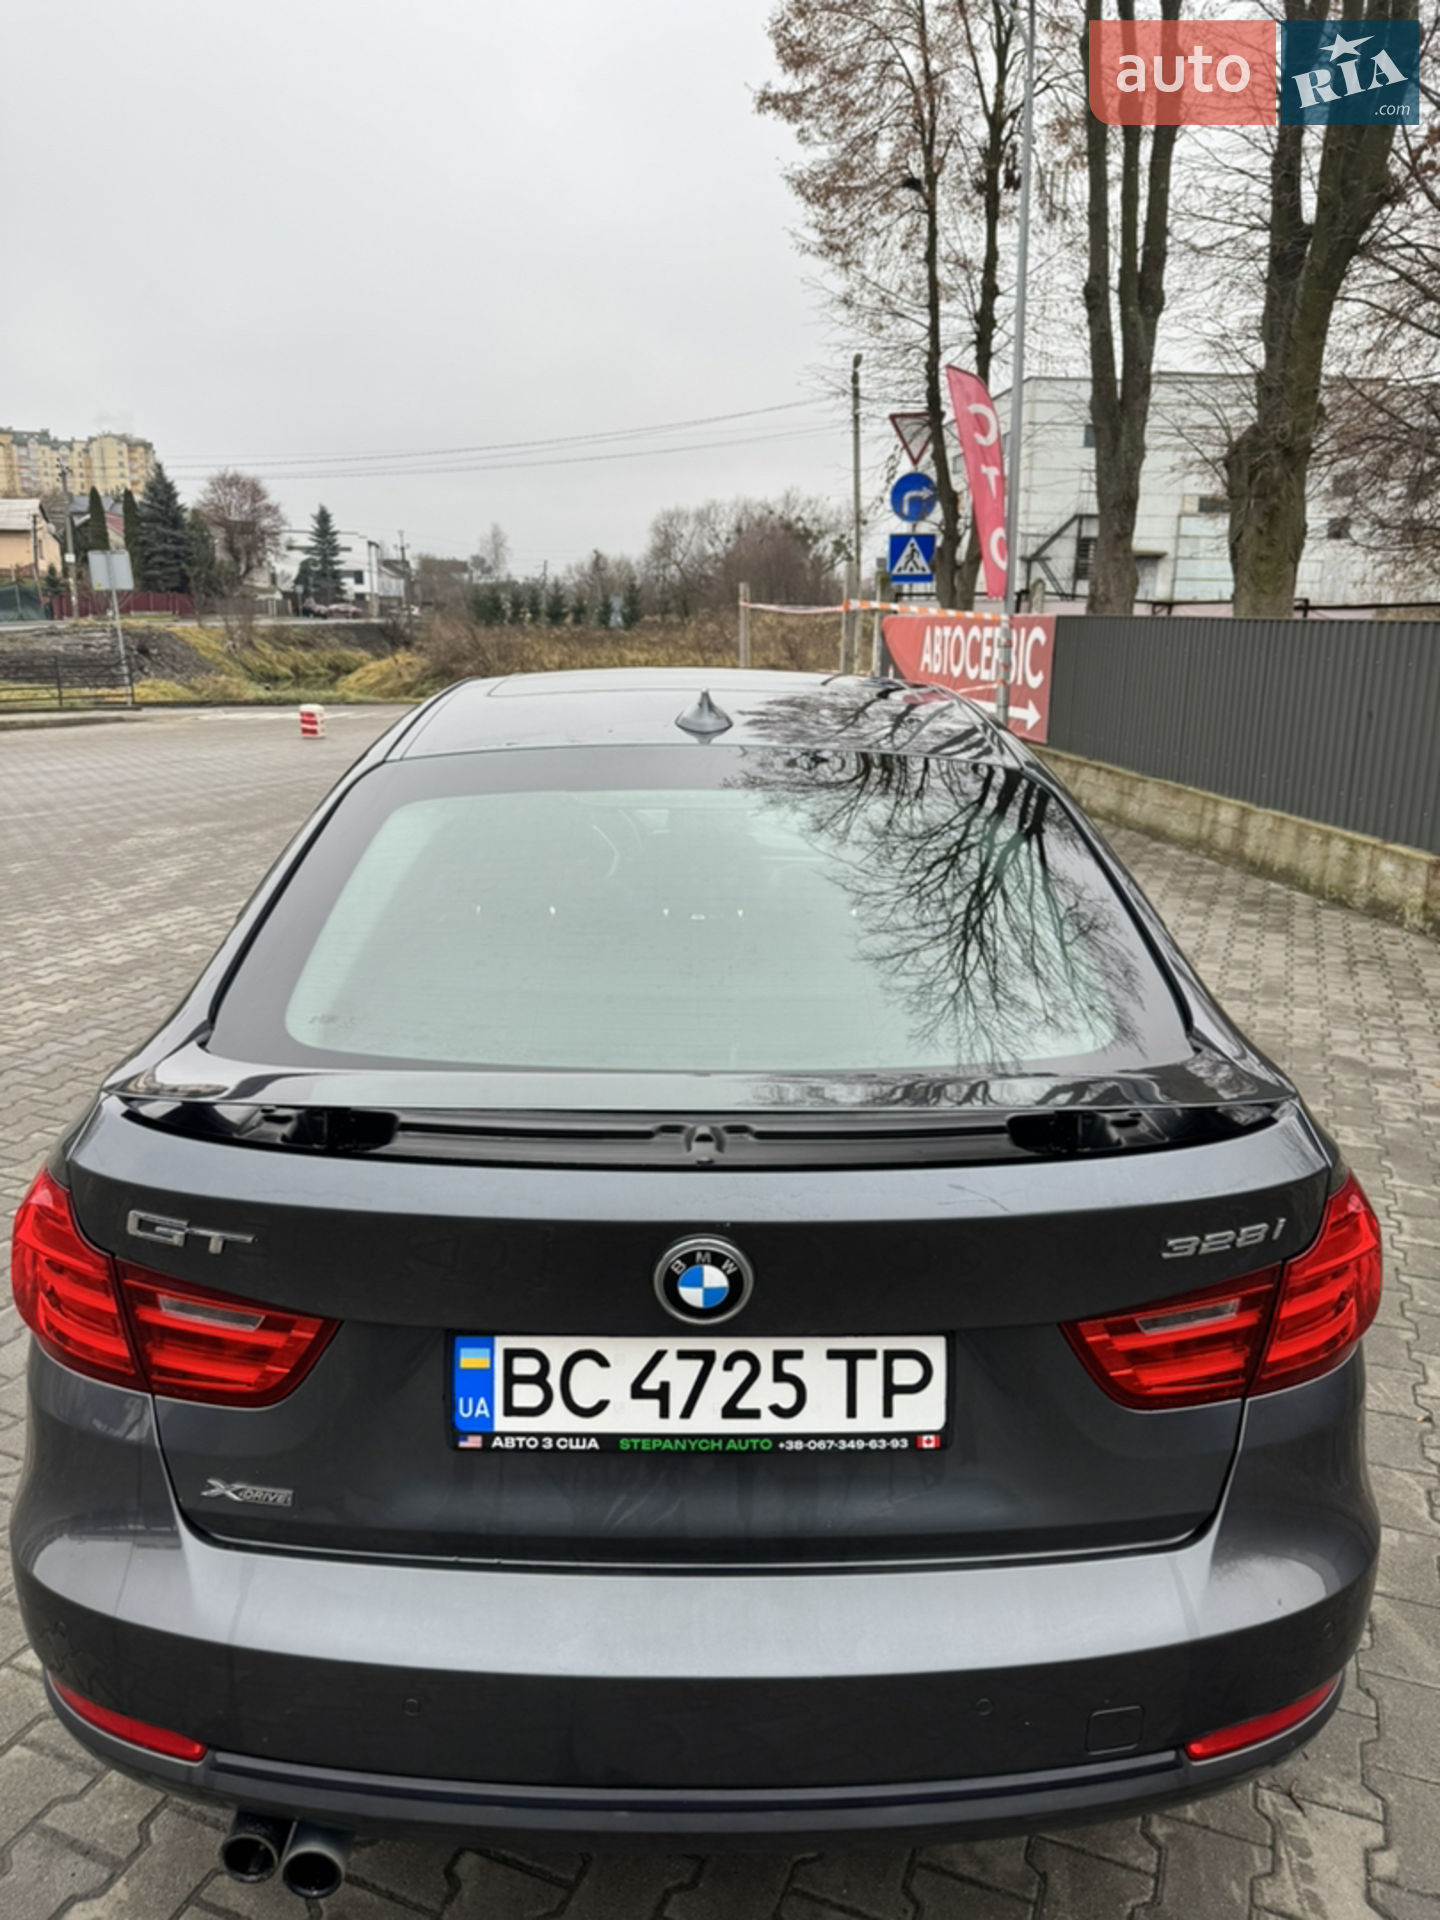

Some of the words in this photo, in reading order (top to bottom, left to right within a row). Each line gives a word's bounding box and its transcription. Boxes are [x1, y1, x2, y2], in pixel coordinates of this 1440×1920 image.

[127, 1210, 257, 1254] GT
[1161, 1217, 1286, 1259] 328i
[670, 1251, 738, 1275] BMW
[503, 1348, 611, 1418] BC
[630, 1349, 807, 1419] 4725
[826, 1349, 933, 1418] TP
[458, 1396, 490, 1418] UA
[491, 1436, 538, 1449] АВТО
[556, 1437, 599, 1449] США
[619, 1438, 722, 1451] STEPANYCH
[725, 1439, 772, 1451] AUTO
